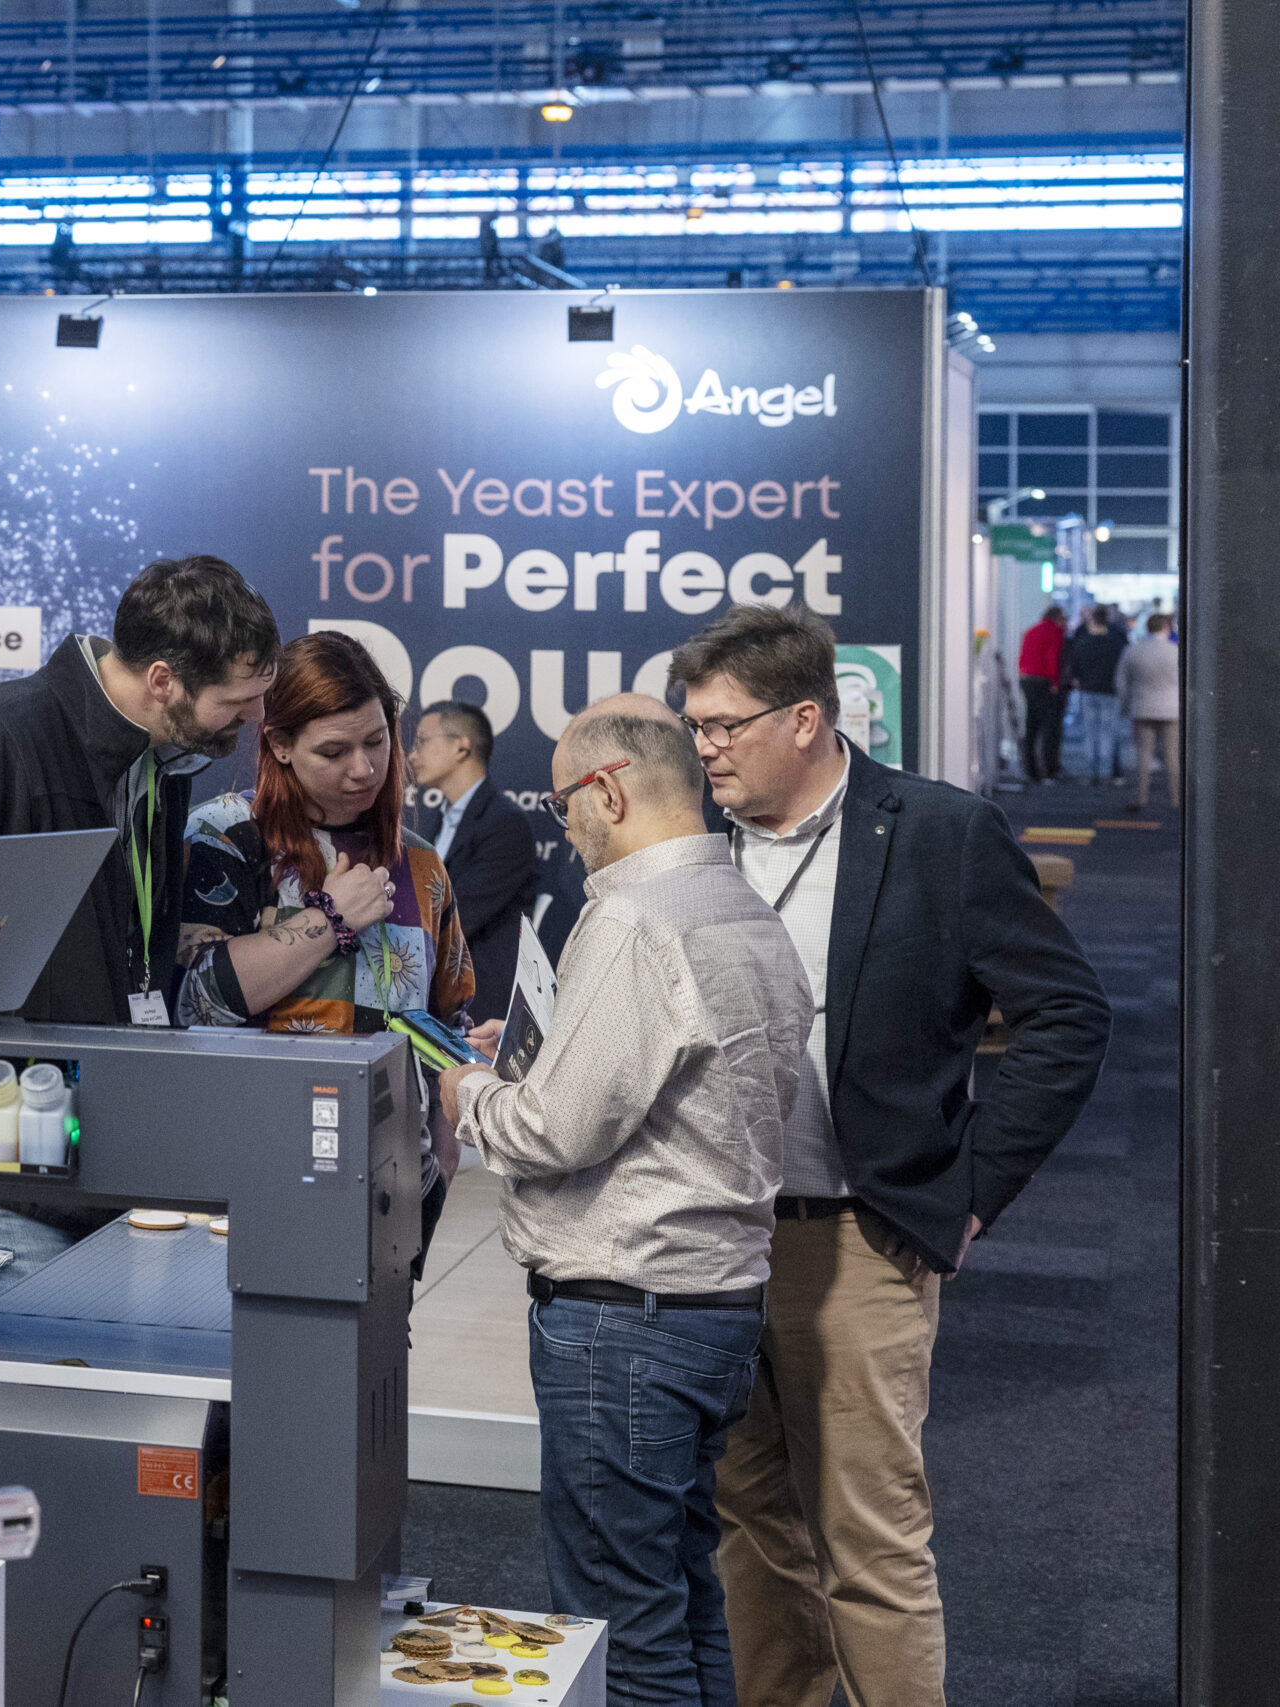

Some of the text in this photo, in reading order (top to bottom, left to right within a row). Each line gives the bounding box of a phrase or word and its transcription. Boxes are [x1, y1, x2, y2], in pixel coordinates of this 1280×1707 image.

[683, 368, 838, 428] Angel
[308, 465, 842, 531] The Yeast Expert
[311, 530, 843, 616] for Perfect
